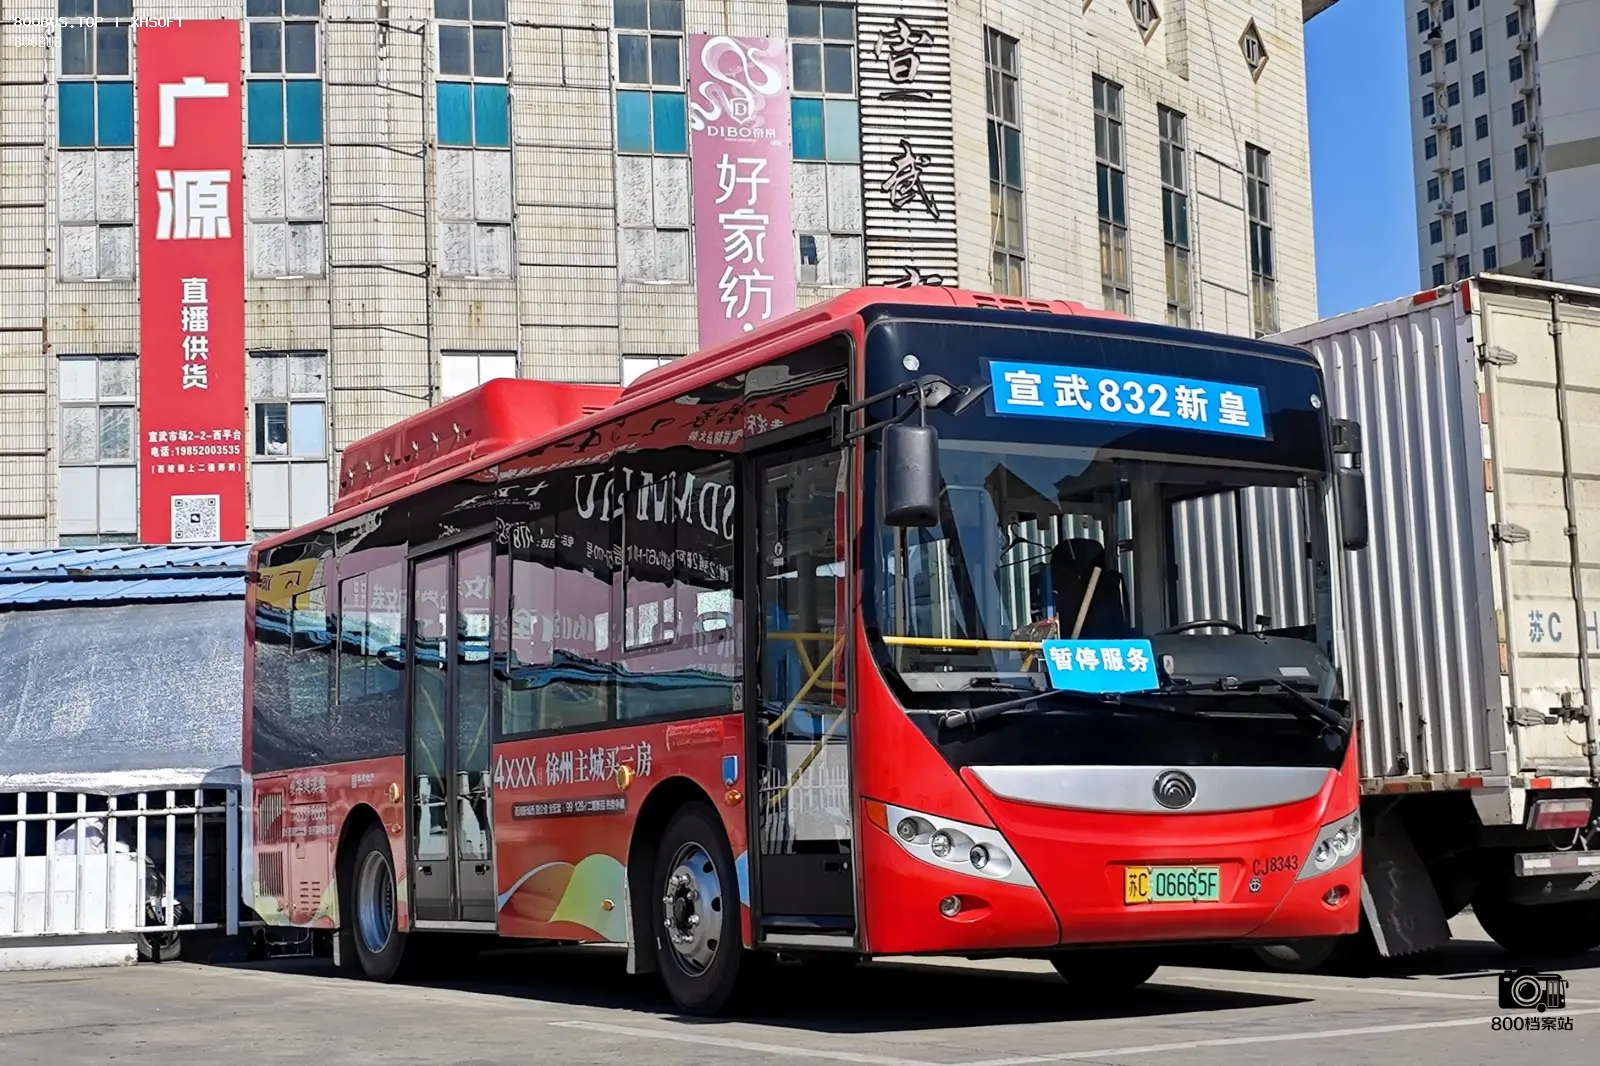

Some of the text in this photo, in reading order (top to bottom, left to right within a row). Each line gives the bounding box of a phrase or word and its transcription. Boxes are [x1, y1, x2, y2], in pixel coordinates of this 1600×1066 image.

[181, 277, 209, 390] 直播供货
[1048, 646, 1149, 673] 暂停服务
[1252, 855, 1299, 877] CJ8343
